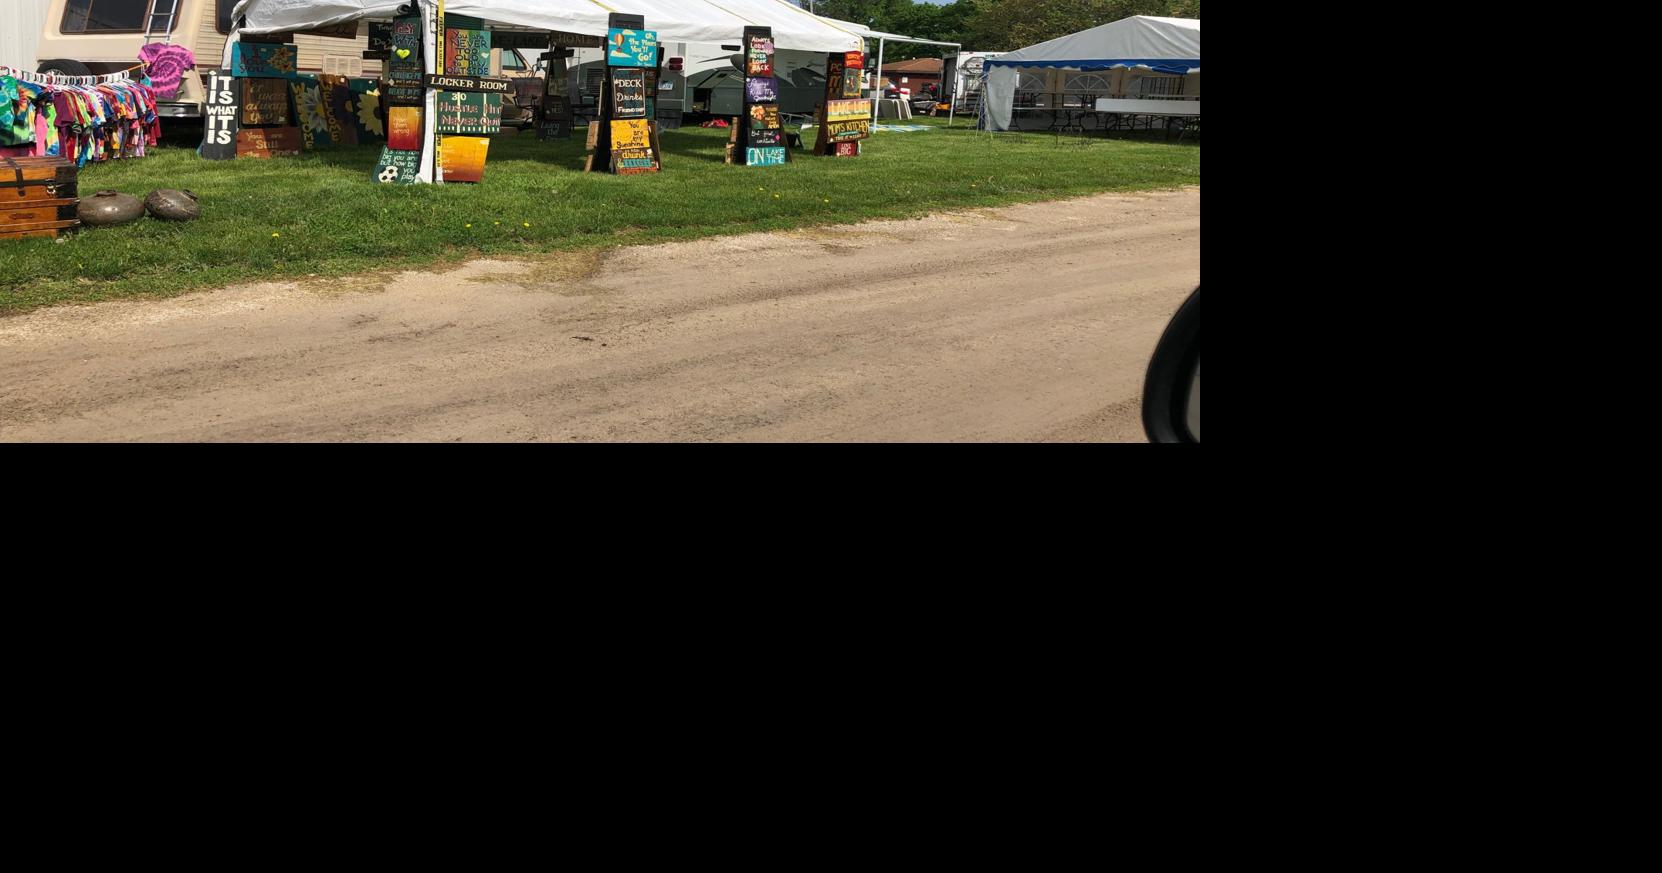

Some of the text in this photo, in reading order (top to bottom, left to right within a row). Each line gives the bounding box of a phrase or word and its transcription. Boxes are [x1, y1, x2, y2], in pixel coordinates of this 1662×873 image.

[451, 38, 487, 48] NEVER
[638, 52, 653, 62] Go!
[447, 67, 489, 75] OUTSIDE
[752, 63, 770, 71] BACK
[431, 77, 508, 90] LOCKER ROOM
[618, 79, 642, 88] DECK
[209, 91, 233, 105] IS
[451, 93, 467, 101] 30
[616, 92, 643, 102] Drinks
[206, 106, 237, 115] WHAT
[209, 116, 234, 129] IT
[207, 130, 232, 144] IS
[747, 147, 764, 165] ON
[840, 147, 852, 155] BIG
[401, 173, 415, 182] play
